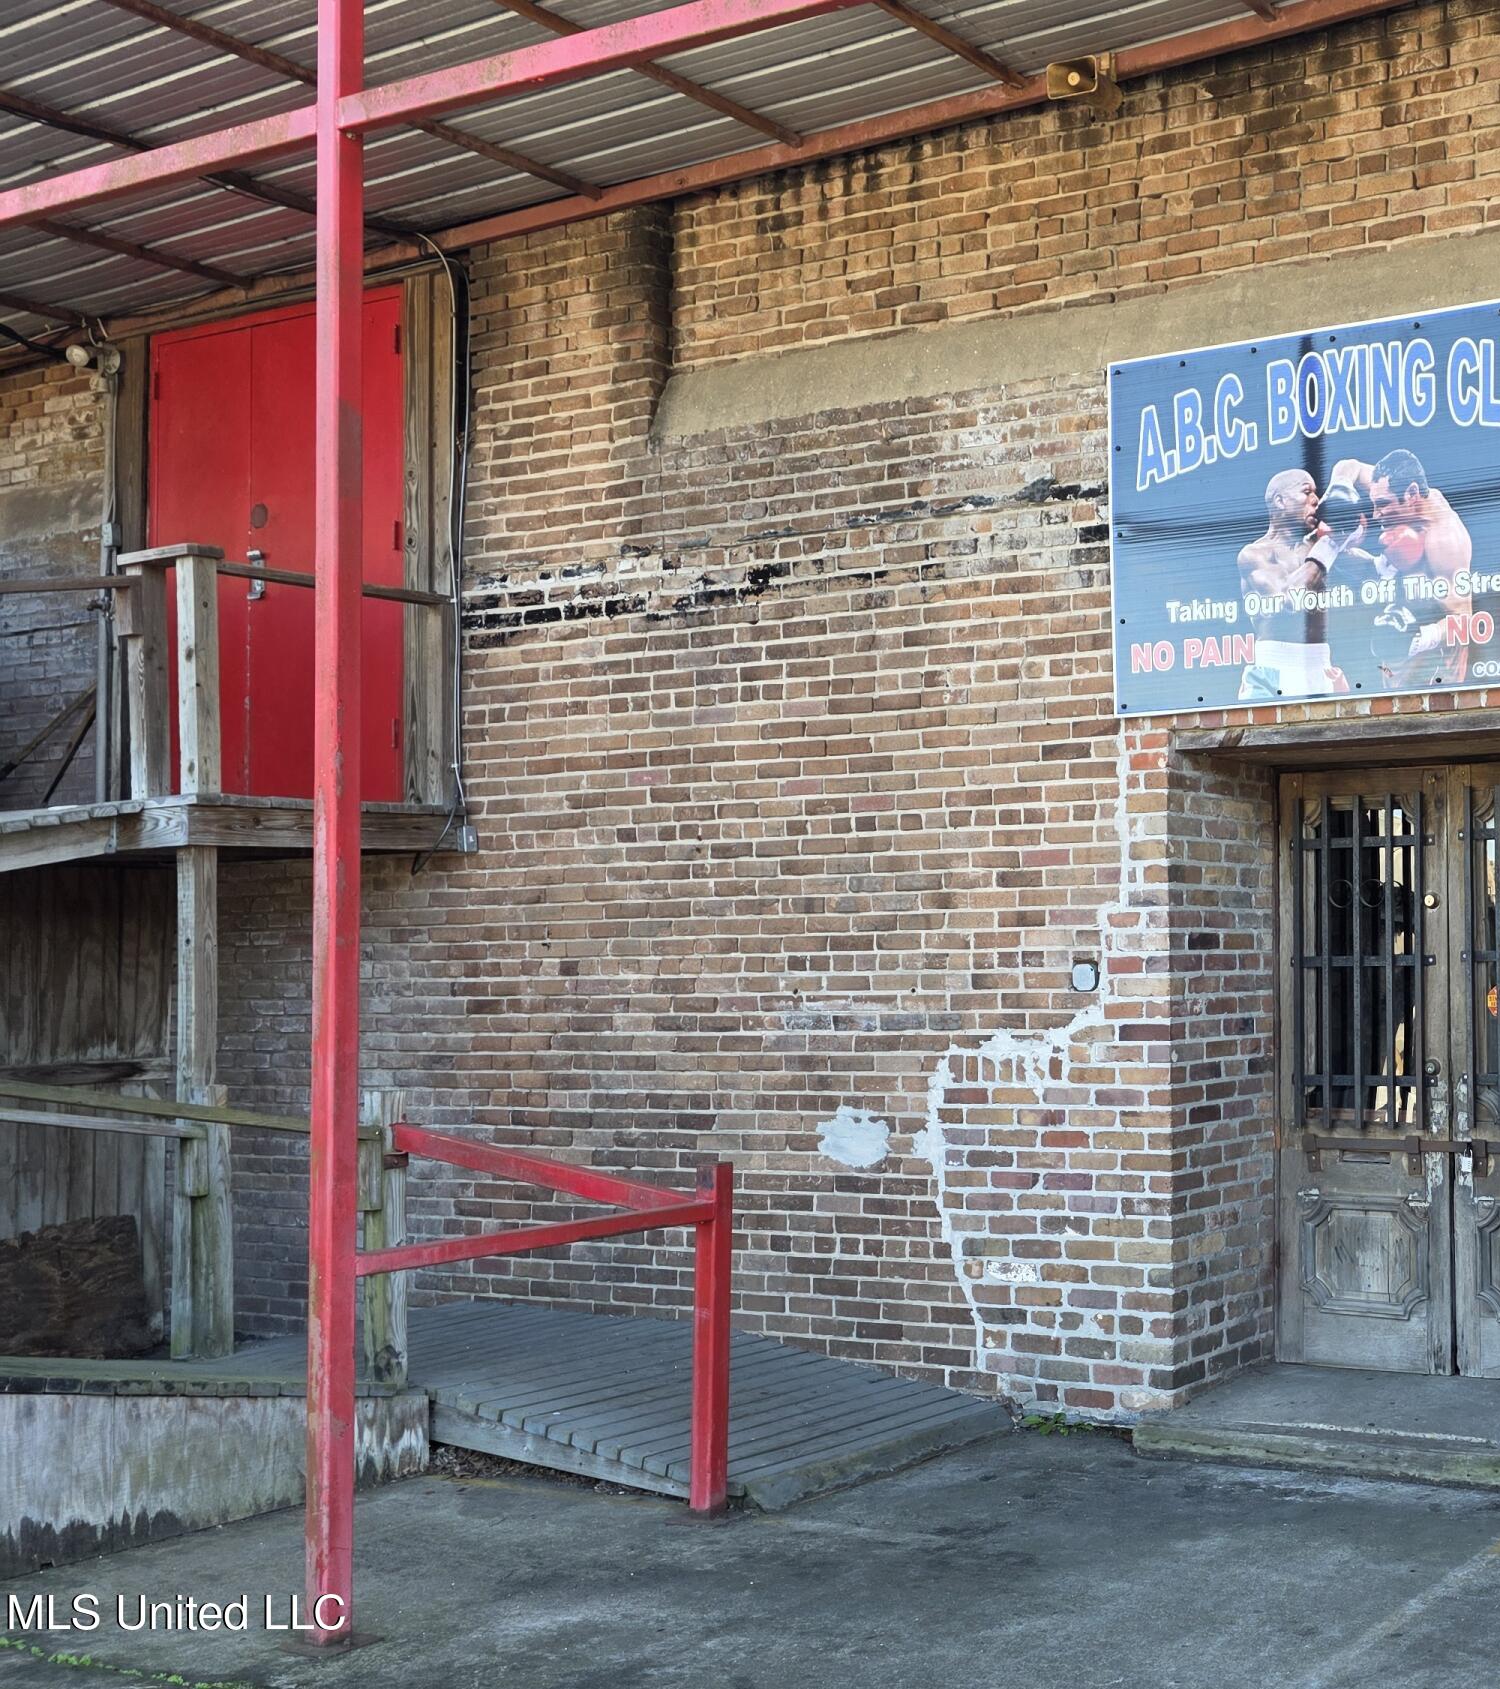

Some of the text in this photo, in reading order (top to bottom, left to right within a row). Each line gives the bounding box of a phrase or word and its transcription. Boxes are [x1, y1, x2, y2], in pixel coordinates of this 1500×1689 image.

[1136, 373, 1258, 492] A.B.C.
[1266, 338, 1437, 446] BOXING
[1166, 599, 1238, 624] Taking
[1244, 592, 1284, 616] Our
[1289, 584, 1354, 612] Youth
[1361, 579, 1396, 605] Off
[1403, 576, 1448, 600] The
[1446, 611, 1494, 647] NO
[1131, 633, 1256, 673] NO PAIN
